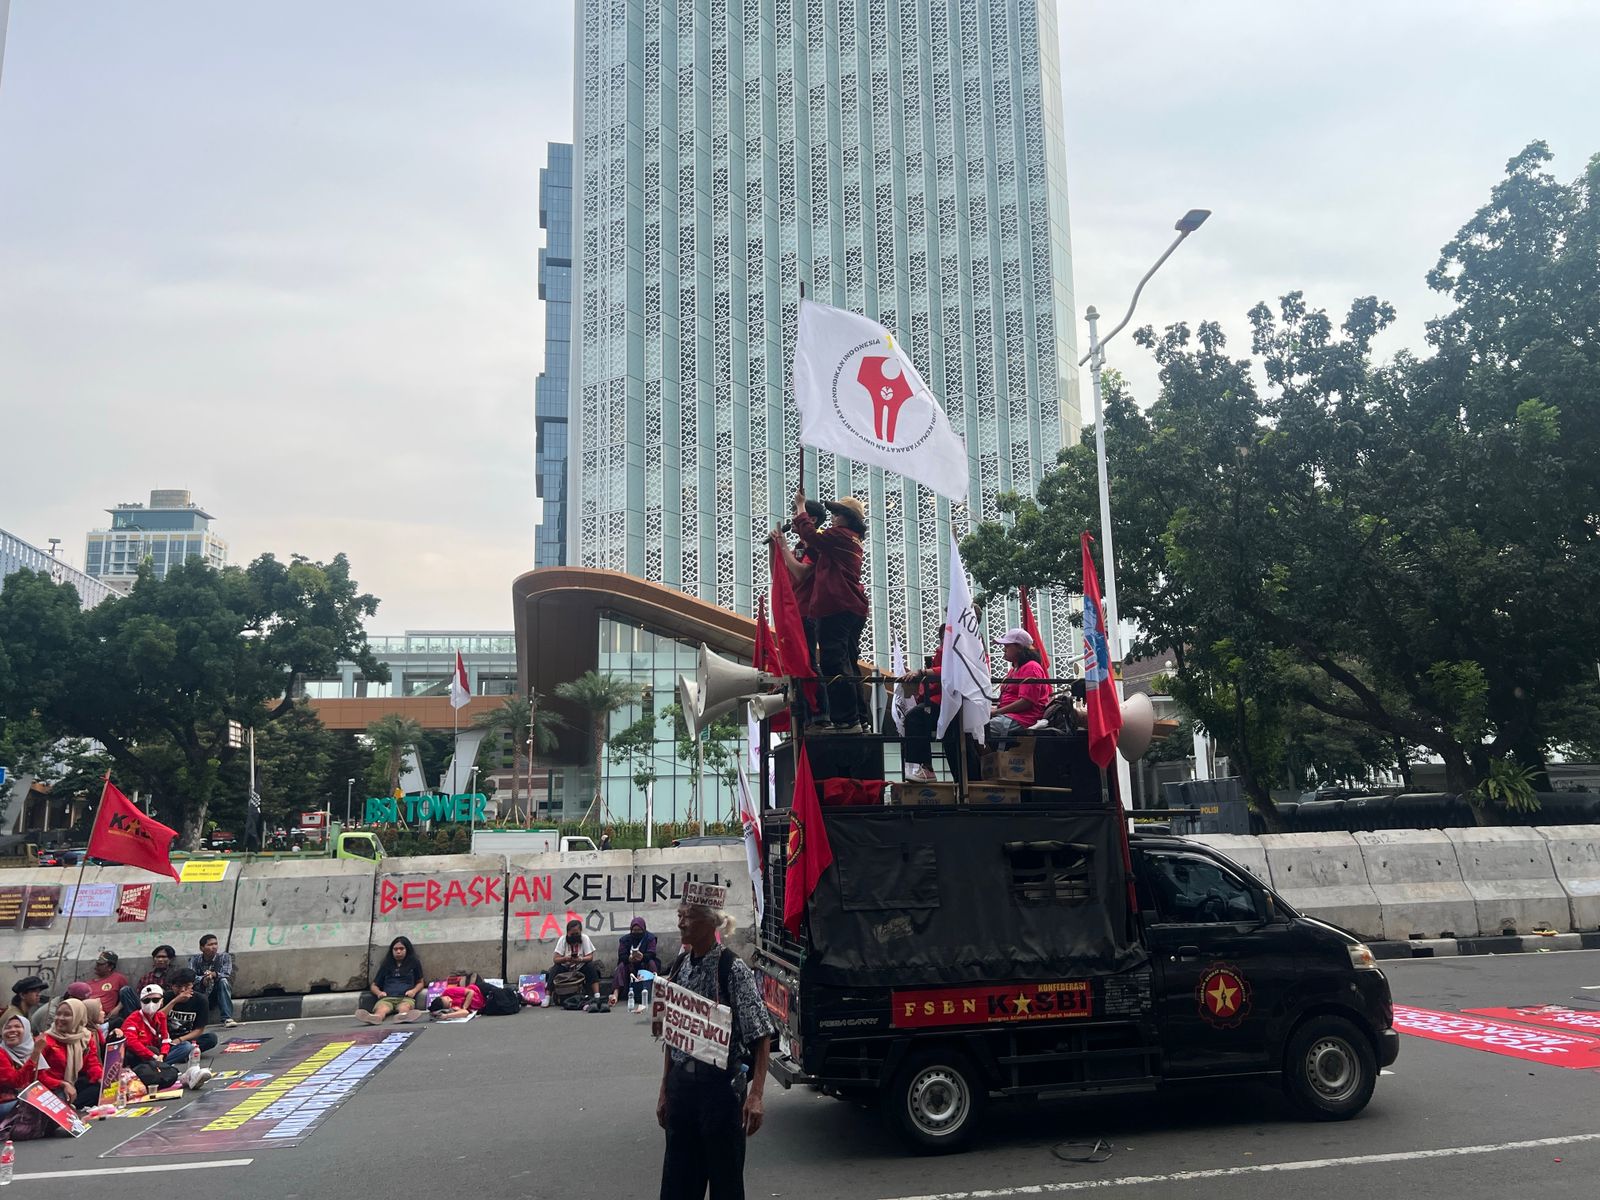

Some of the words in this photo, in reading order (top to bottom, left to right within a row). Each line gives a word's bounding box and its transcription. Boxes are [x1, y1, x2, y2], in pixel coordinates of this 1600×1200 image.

[831, 361, 845, 408] PENDIDIKAN
[843, 338, 881, 362] INDONESIA
[366, 797, 397, 823] BSI
[403, 793, 487, 823] TOWER
[1200, 806, 1219, 814] POLISI
[380, 874, 552, 914] BEBASKAN
[1038, 982, 1087, 992] KONFEDERASI
[665, 1027, 695, 1055] SATU
